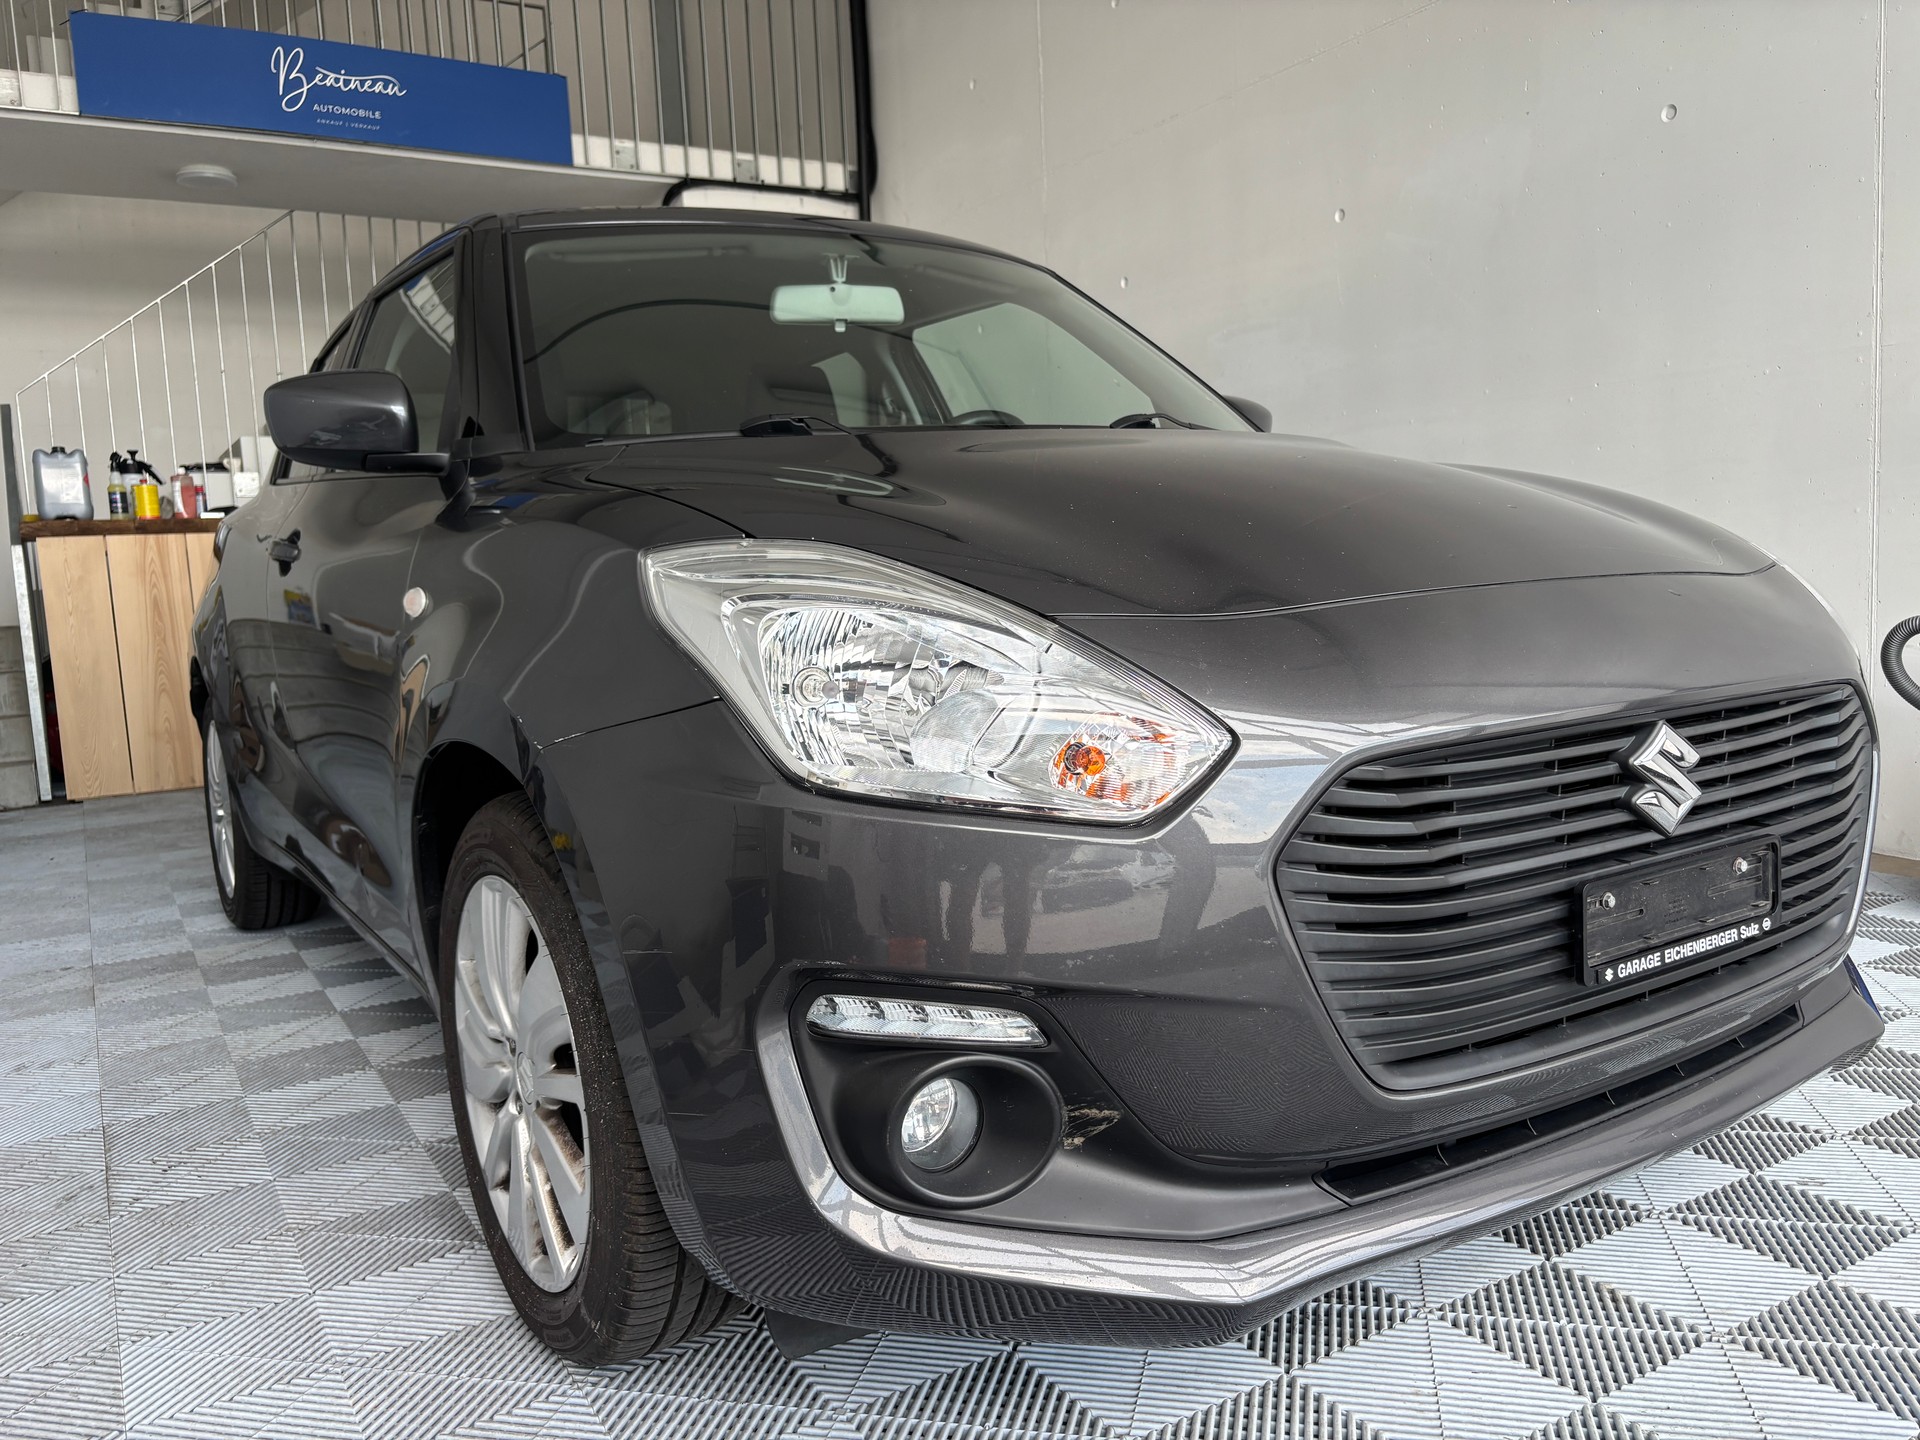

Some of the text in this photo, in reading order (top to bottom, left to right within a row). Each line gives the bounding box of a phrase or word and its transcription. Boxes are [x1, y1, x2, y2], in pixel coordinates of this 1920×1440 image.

[312, 103, 382, 120] AUTOMOBILE
[316, 118, 343, 126] ANKAUF
[350, 122, 380, 131] VERKAUF
[1617, 922, 1760, 978] GARAGE EICHENBERGER Sulz
